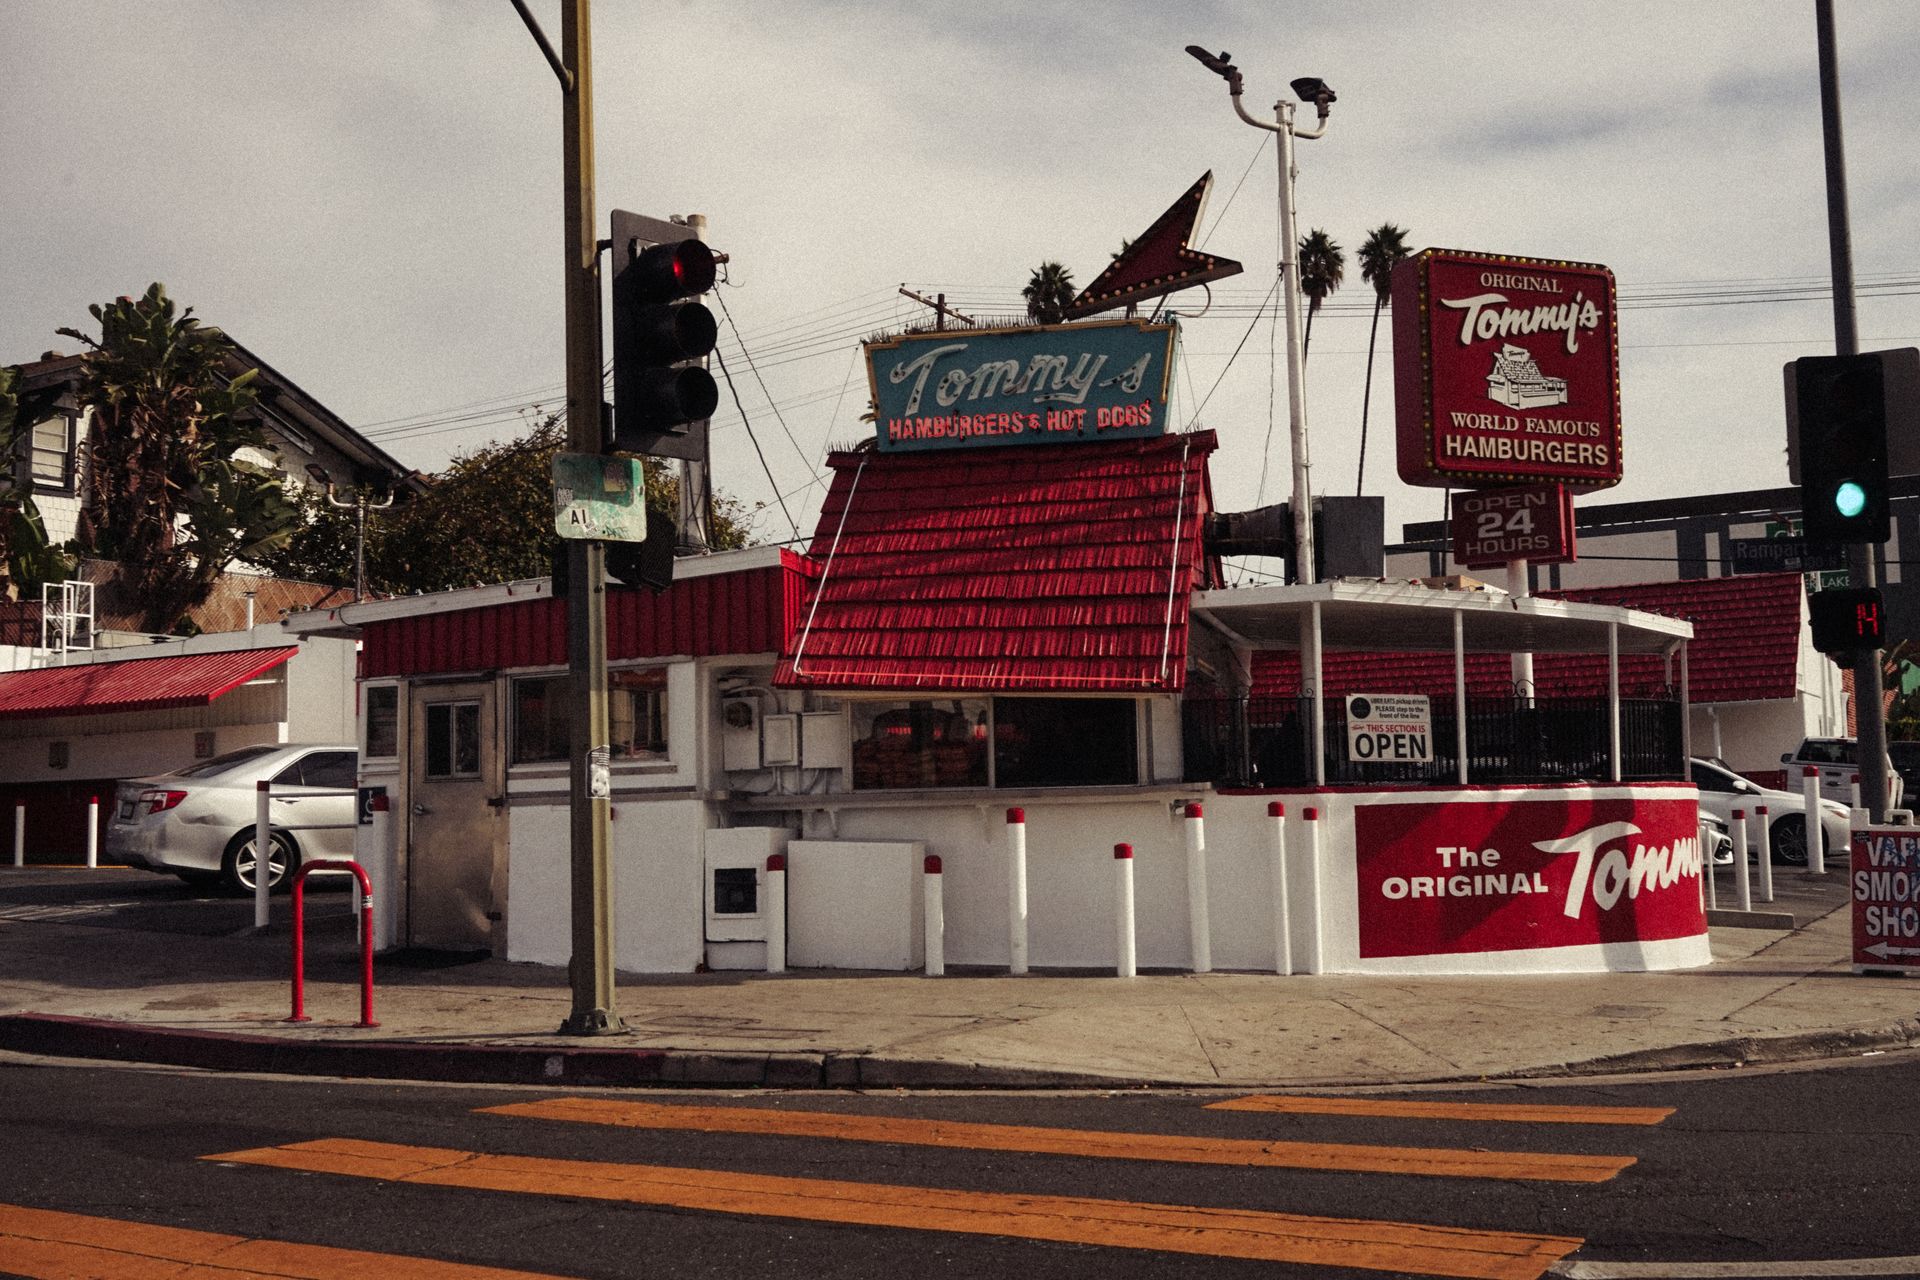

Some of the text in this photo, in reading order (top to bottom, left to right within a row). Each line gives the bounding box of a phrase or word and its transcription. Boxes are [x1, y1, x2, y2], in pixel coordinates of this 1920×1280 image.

[1480, 272, 1563, 293] ORIGINAL
[1441, 291, 1603, 354] Tommy's
[889, 413, 1023, 440] HAMBURGERS
[1048, 409, 1087, 432] HOT
[1098, 405, 1152, 428] DOGS
[1450, 412, 1600, 438] WORLD FAMOUS
[1446, 434, 1608, 466] HAMBURGERS
[1464, 491, 1546, 513] OPEN
[1477, 509, 1535, 538] 24
[1466, 535, 1550, 556] HOURS
[1736, 541, 1809, 561] Rampart
[1821, 576, 1850, 588] LAKE
[1366, 724, 1426, 733] THIS SECTION IS
[1355, 733, 1427, 759] OPEN
[1436, 847, 1501, 868] The
[1867, 837, 1920, 867] VAP
[1381, 872, 1549, 900] ORIGINAL
